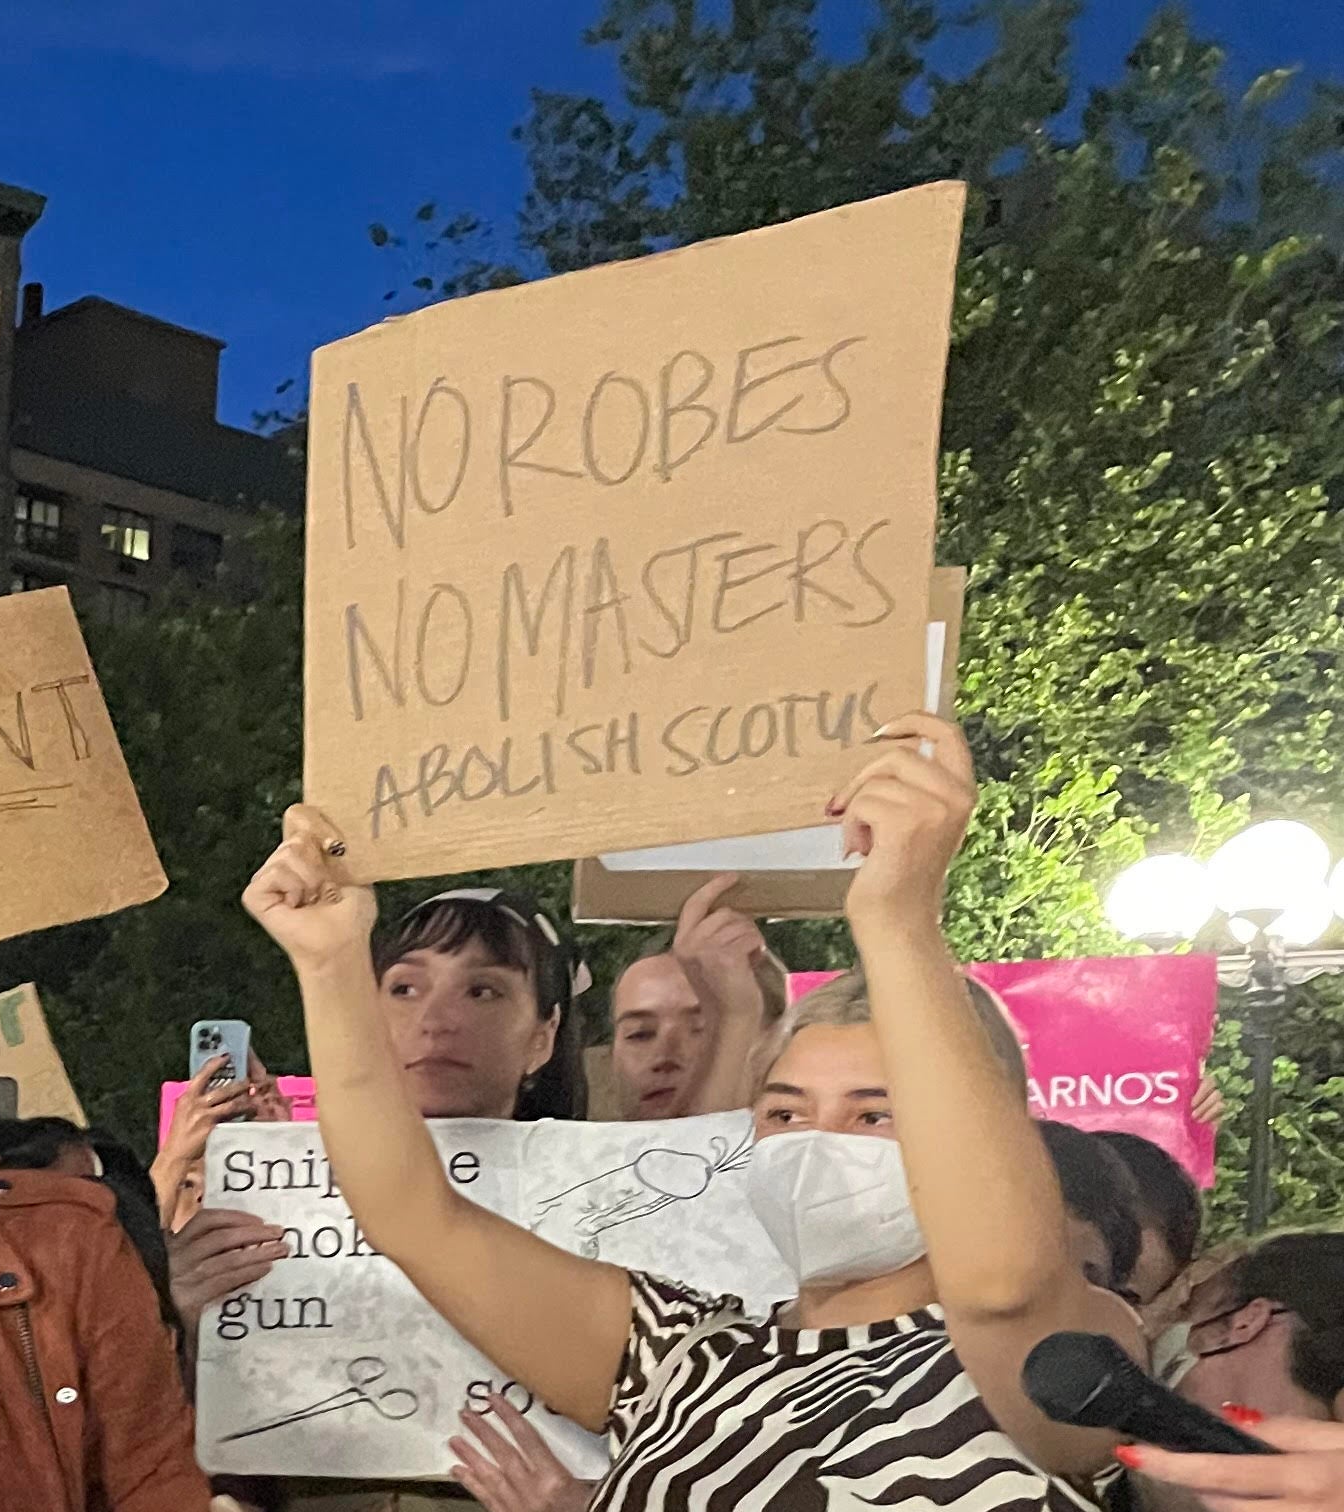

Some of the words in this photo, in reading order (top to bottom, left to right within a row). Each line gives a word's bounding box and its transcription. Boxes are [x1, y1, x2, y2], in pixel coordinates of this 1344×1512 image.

[342, 376, 471, 550] NO
[500, 335, 868, 518] ROBES
[346, 578, 474, 722] NO
[499, 518, 896, 722] MASTERS
[368, 711, 639, 839] ABOLISH
[661, 681, 887, 776] SCOTUS
[1026, 1071, 1180, 1109] ARNOS
[217, 1292, 333, 1341] gun
